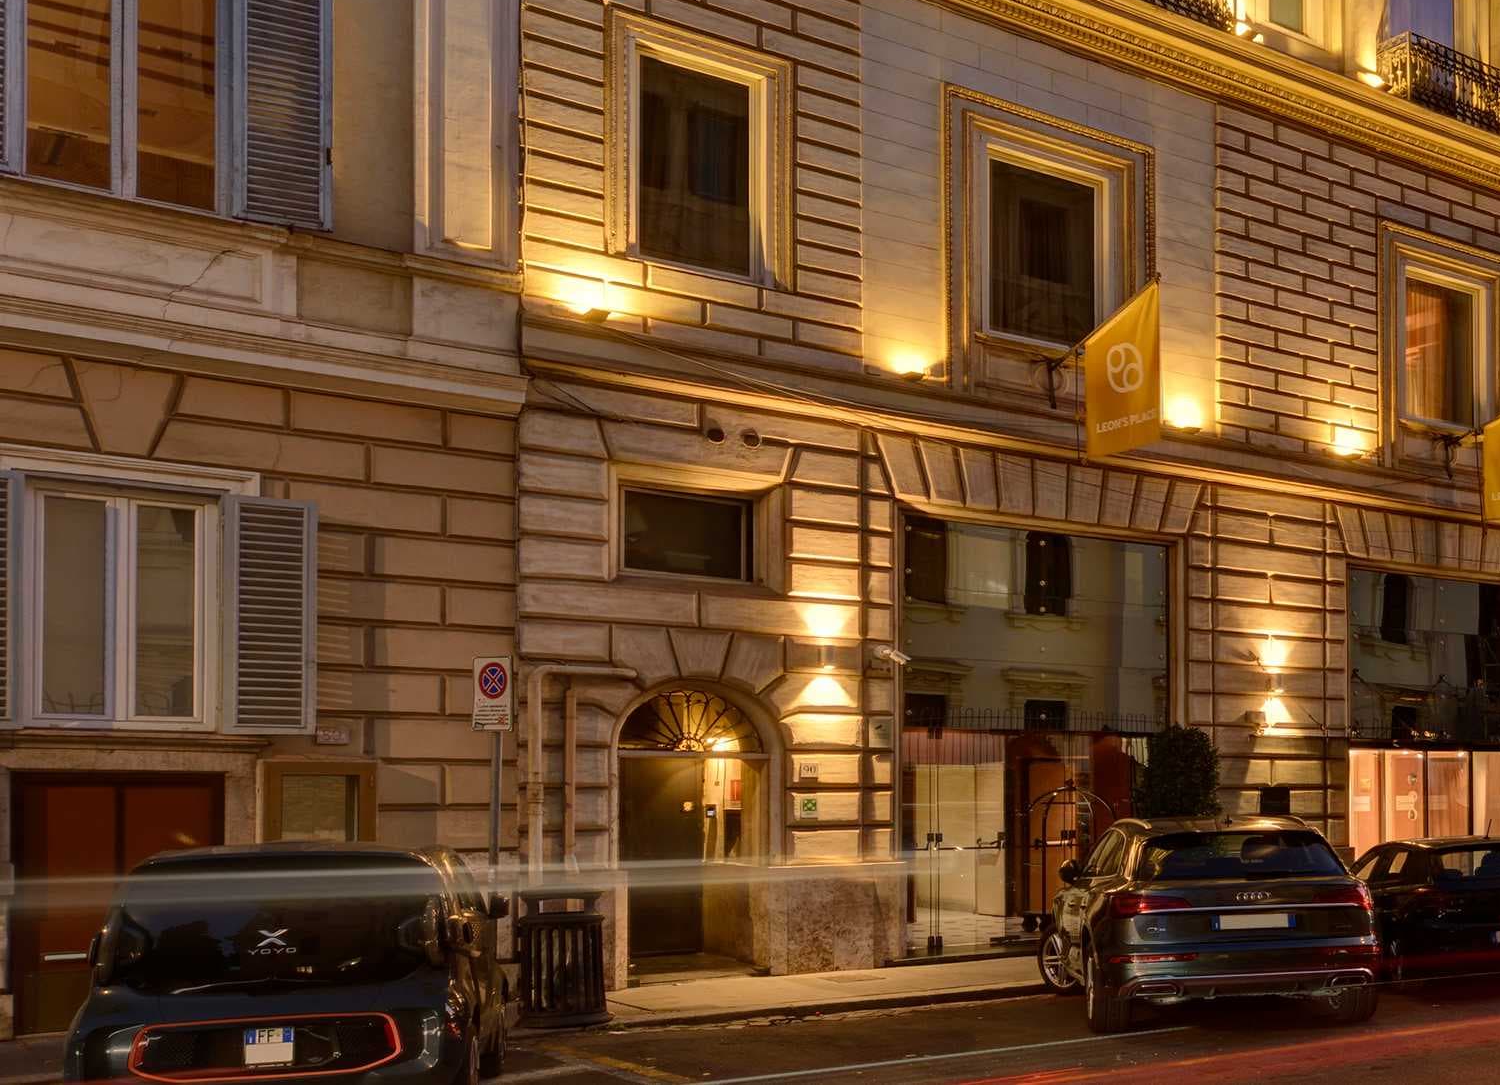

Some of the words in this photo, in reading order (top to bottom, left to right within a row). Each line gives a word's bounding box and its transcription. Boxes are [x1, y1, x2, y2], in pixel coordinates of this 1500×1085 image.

[1096, 417, 1129, 434] LEON'S
[803, 765, 817, 774] 90
[248, 947, 297, 956] YOYO
